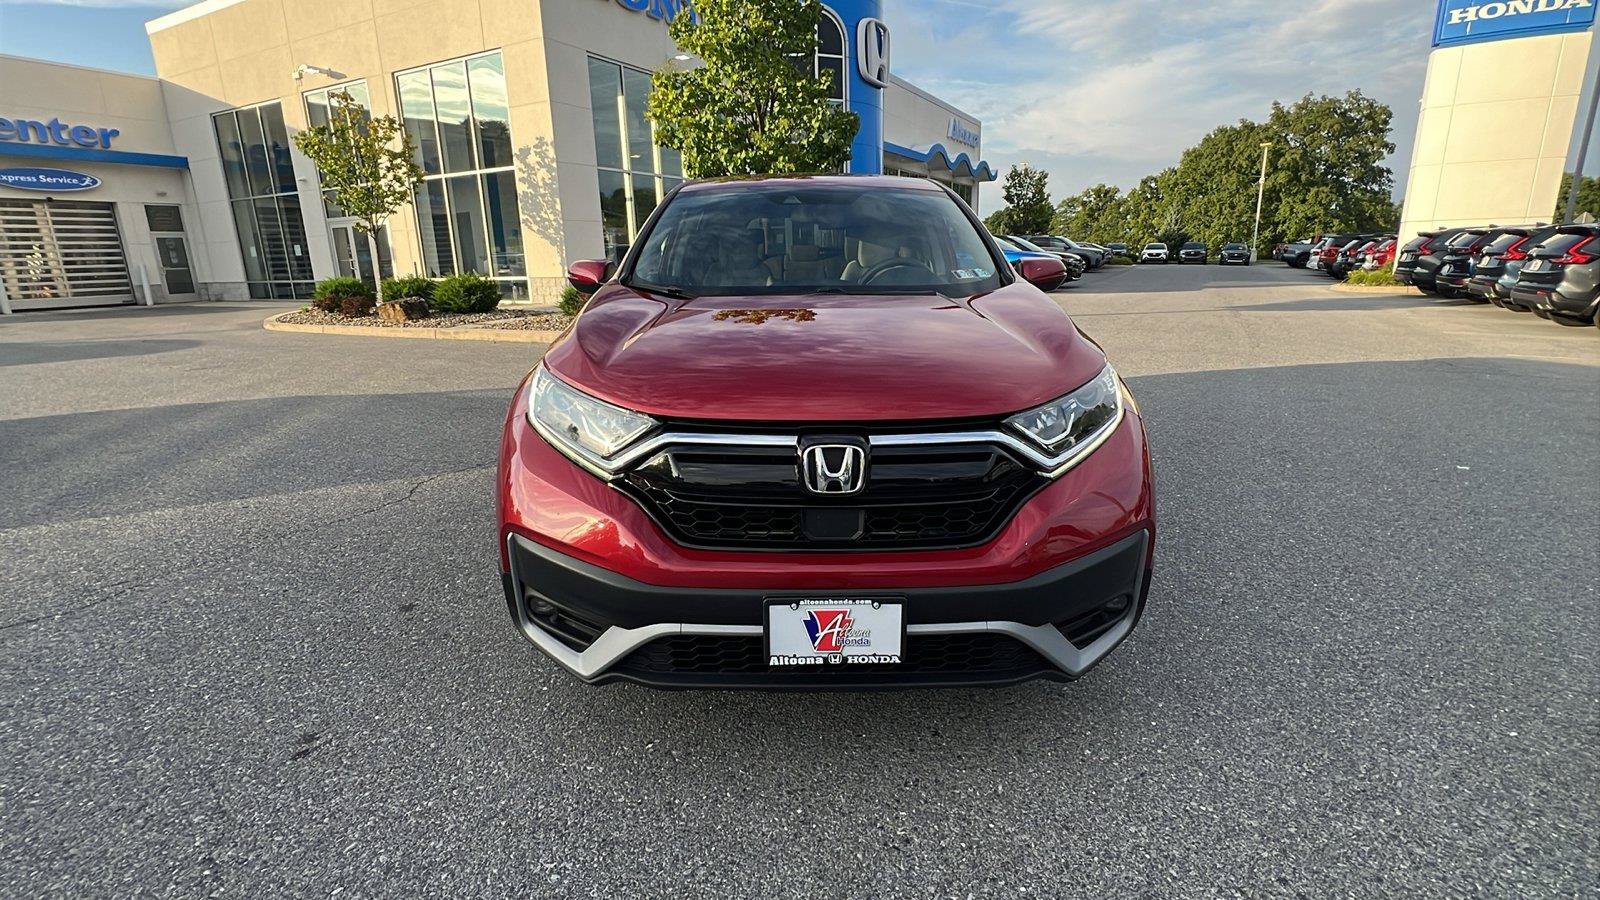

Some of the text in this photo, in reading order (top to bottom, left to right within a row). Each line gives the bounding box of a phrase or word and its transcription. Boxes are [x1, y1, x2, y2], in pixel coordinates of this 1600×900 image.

[0, 174, 78, 184] xpress Service
[815, 613, 870, 647] Altoona
[837, 637, 870, 646] Honda
[769, 656, 901, 666] Altoona HONDA
